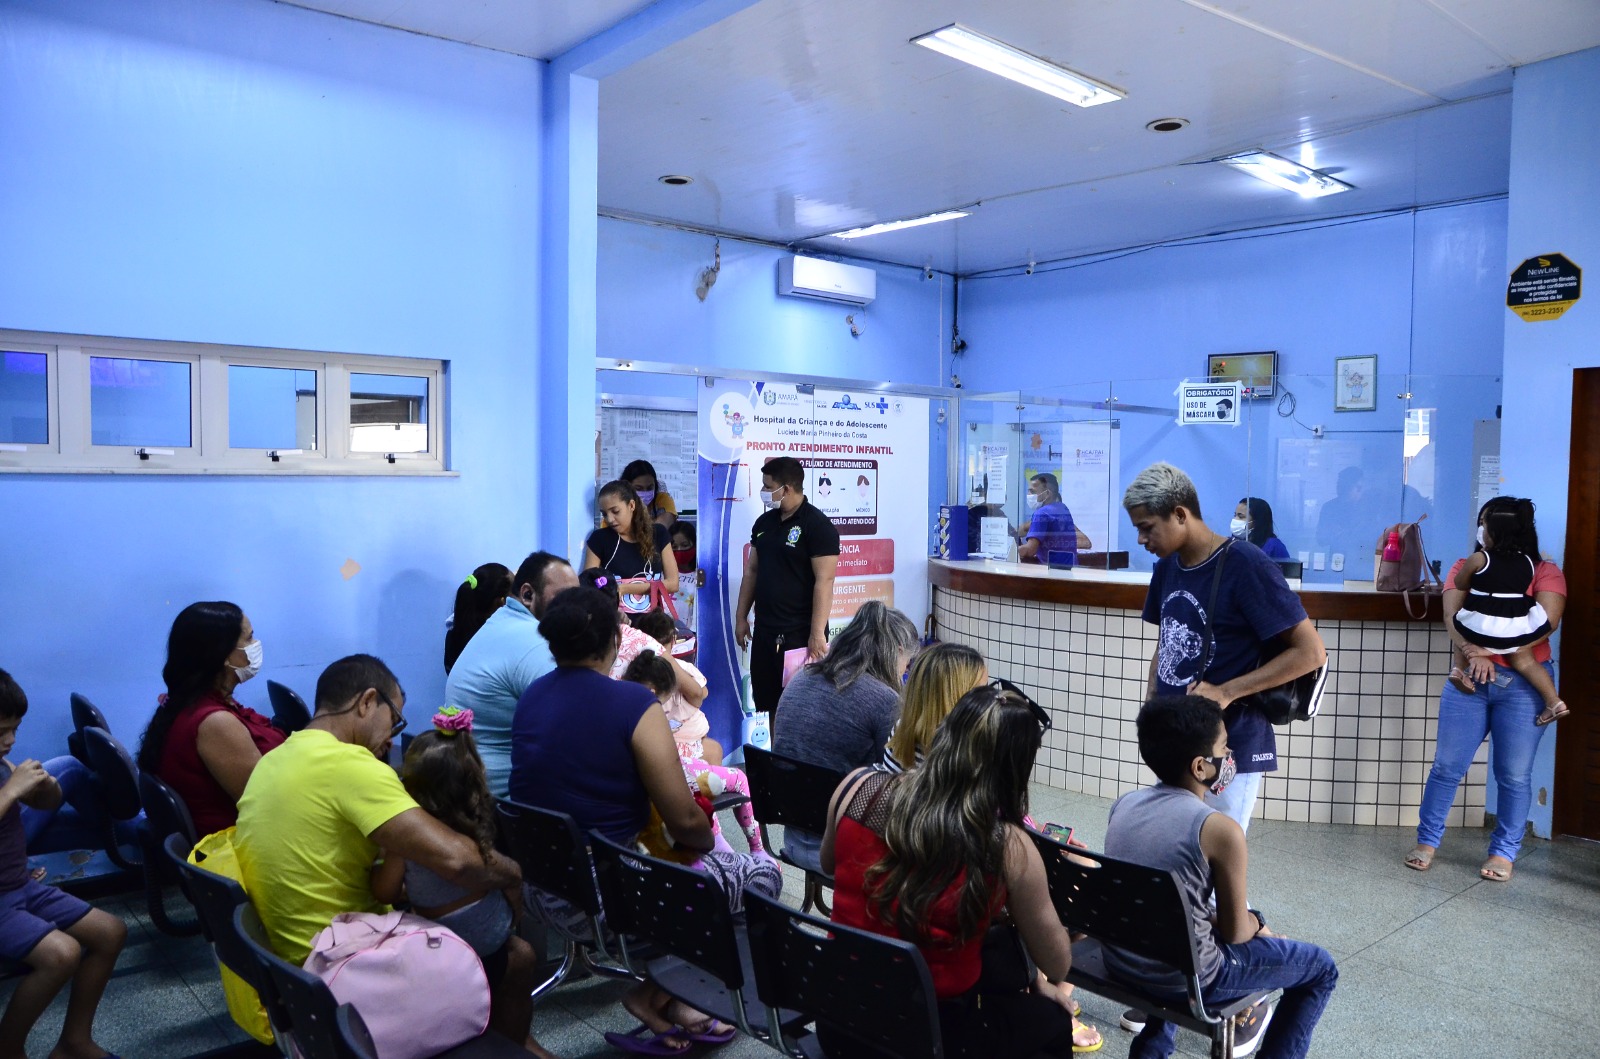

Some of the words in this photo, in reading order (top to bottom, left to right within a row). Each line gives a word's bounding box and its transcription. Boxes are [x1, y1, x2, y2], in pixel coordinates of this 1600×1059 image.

[754, 415, 785, 424] Hospital
[799, 418, 827, 427] Criança
[846, 420, 888, 429] Adolescente
[746, 441, 785, 451] PRONTO
[789, 443, 853, 453] ATENDIMENTO
[856, 446, 893, 454] INFANTIL
[839, 544, 860, 554] ÊNCIA
[833, 585, 866, 595] URGENTE
